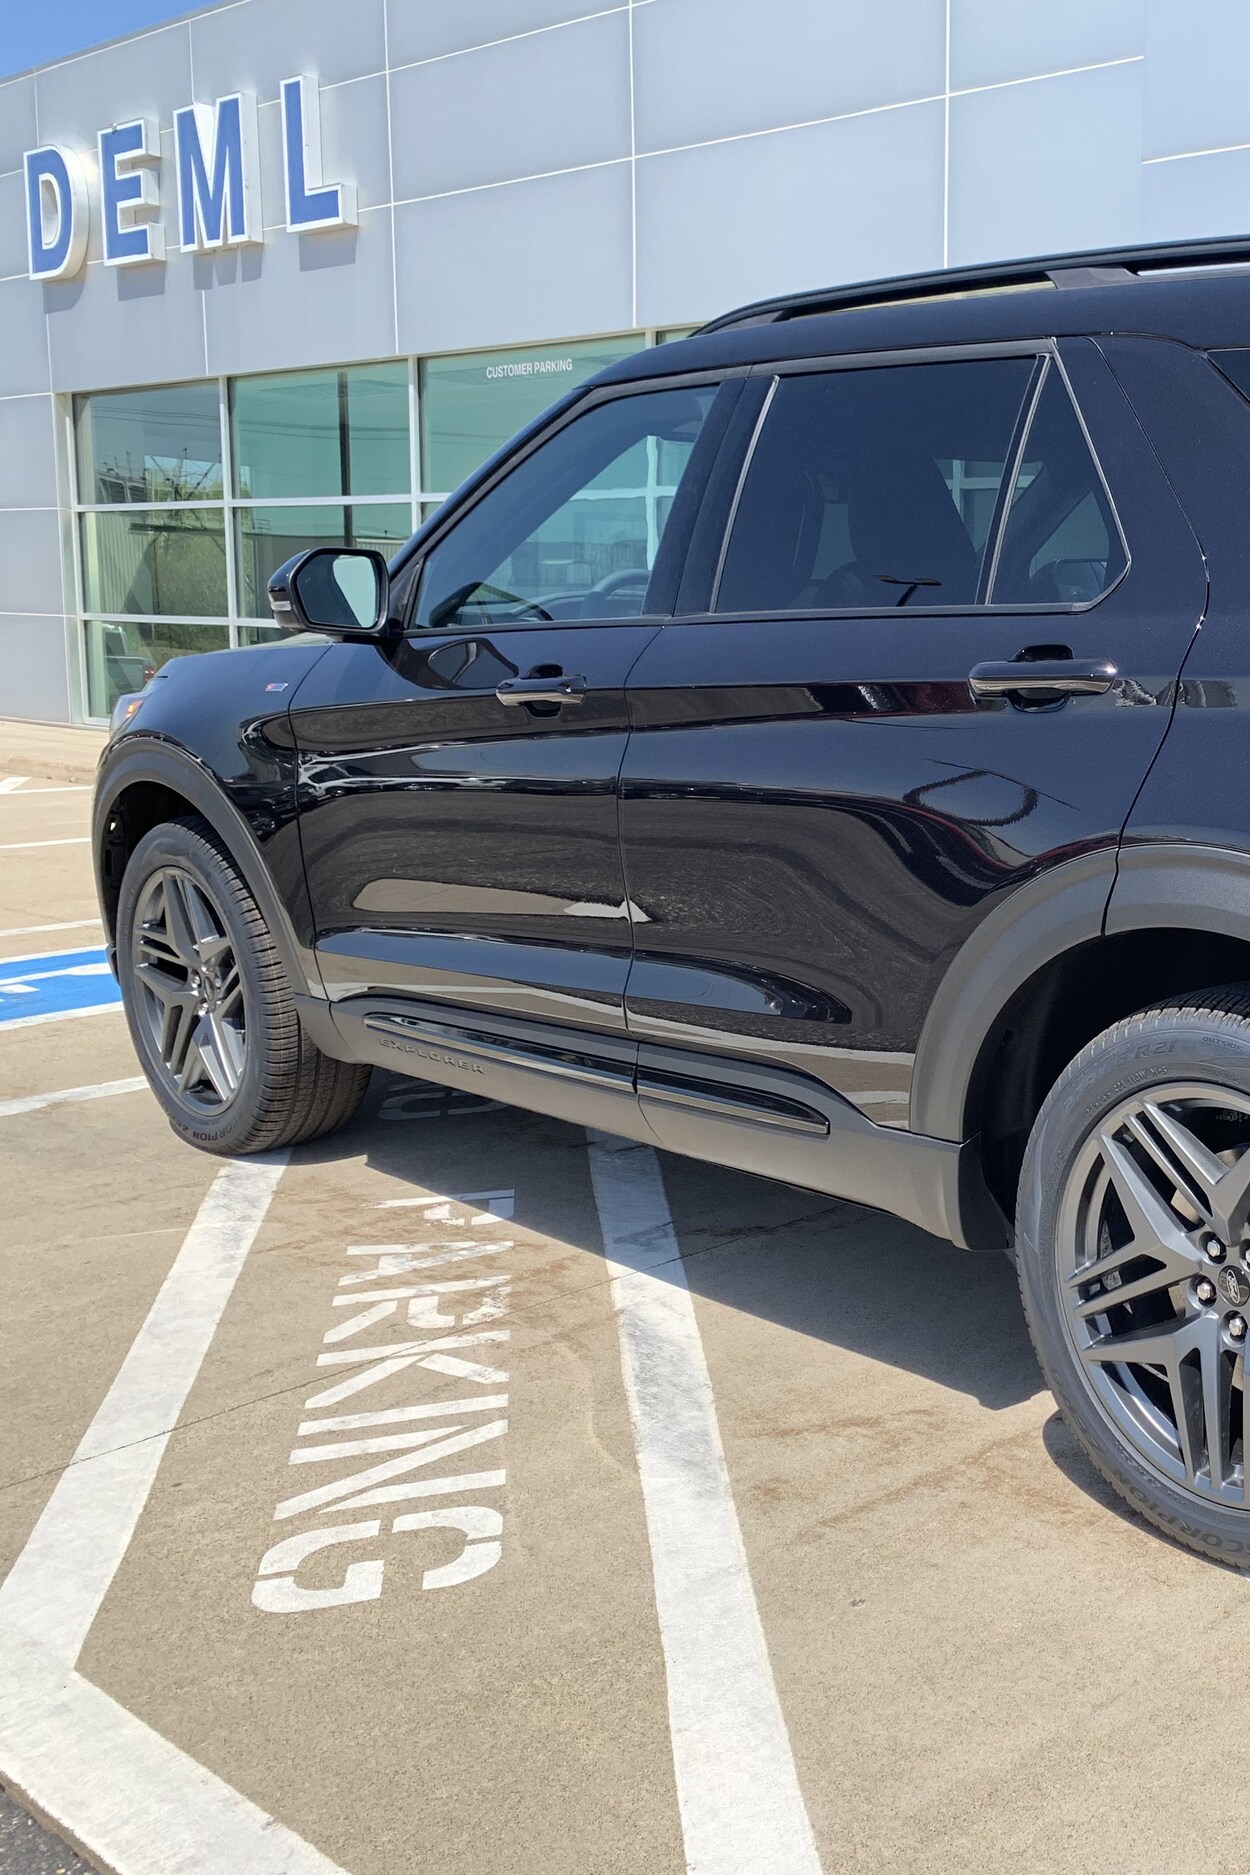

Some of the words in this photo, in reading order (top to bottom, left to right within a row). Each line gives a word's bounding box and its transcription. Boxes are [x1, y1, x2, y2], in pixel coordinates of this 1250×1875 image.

[23, 74, 357, 281] DEML
[486, 362, 533, 379] CUSTOMER
[534, 359, 573, 374] PARKING
[378, 1037, 486, 1075] EXPLORER
[193, 1114, 241, 1141] ORPION
[251, 1189, 515, 1613] PARKING
